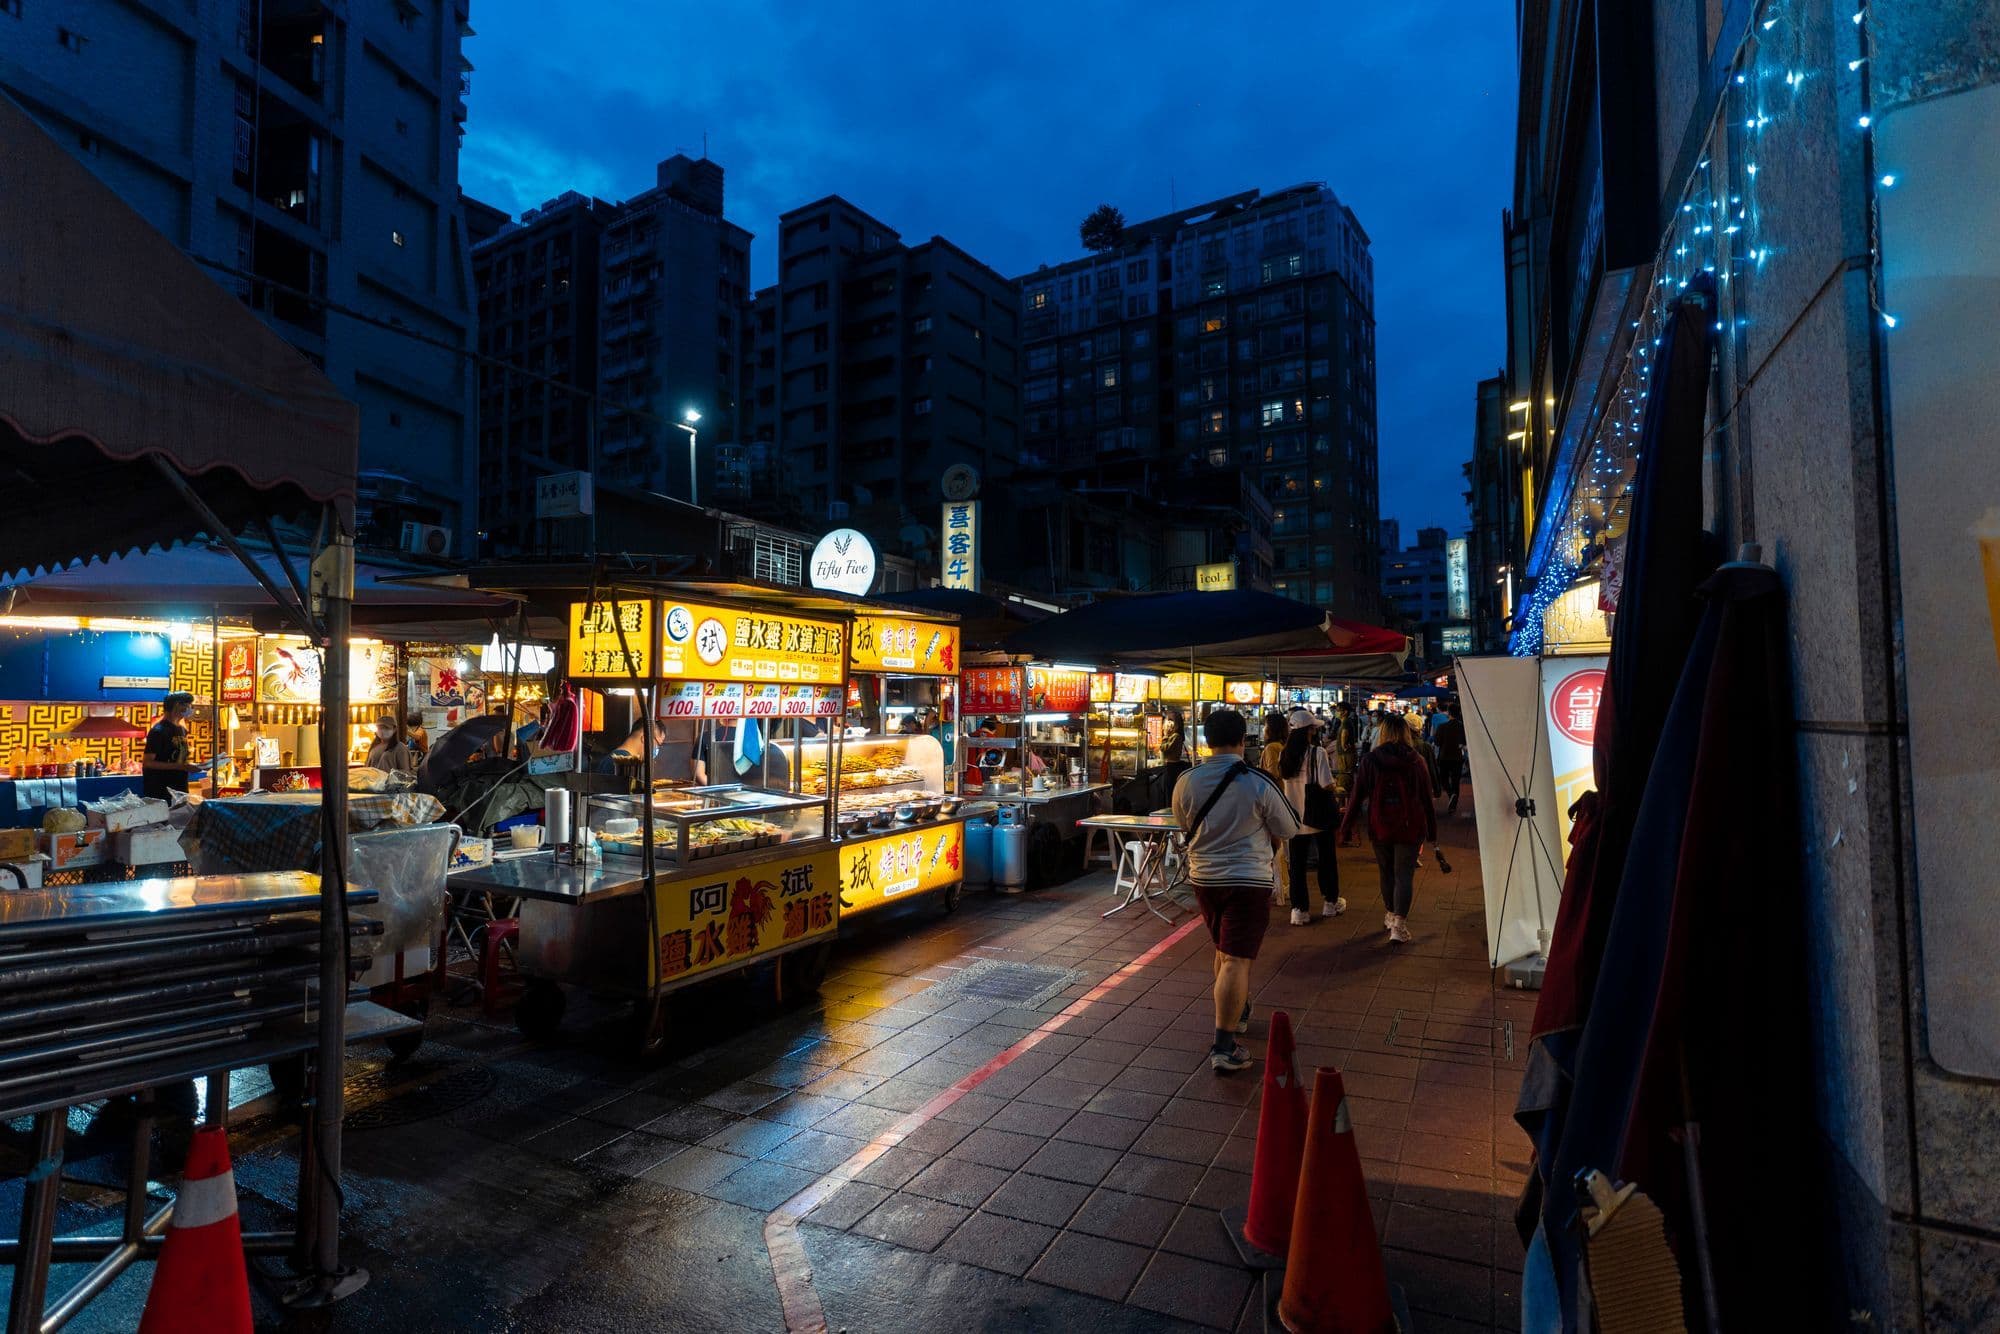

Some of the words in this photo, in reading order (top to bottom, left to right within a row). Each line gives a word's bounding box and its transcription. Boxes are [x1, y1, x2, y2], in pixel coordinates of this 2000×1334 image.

[816, 559, 843, 581] Fifty
[845, 559, 869, 575] Five
[734, 616, 783, 652] 鹽水雞
[784, 622, 842, 656] 冰鎮滷味
[1568, 685, 1603, 708] 台
[1567, 709, 1594, 731] 運
[688, 882, 729, 921] 阿
[779, 863, 814, 898] 斌
[660, 912, 759, 979] 鹽水雞
[782, 891, 833, 940] 滷味
